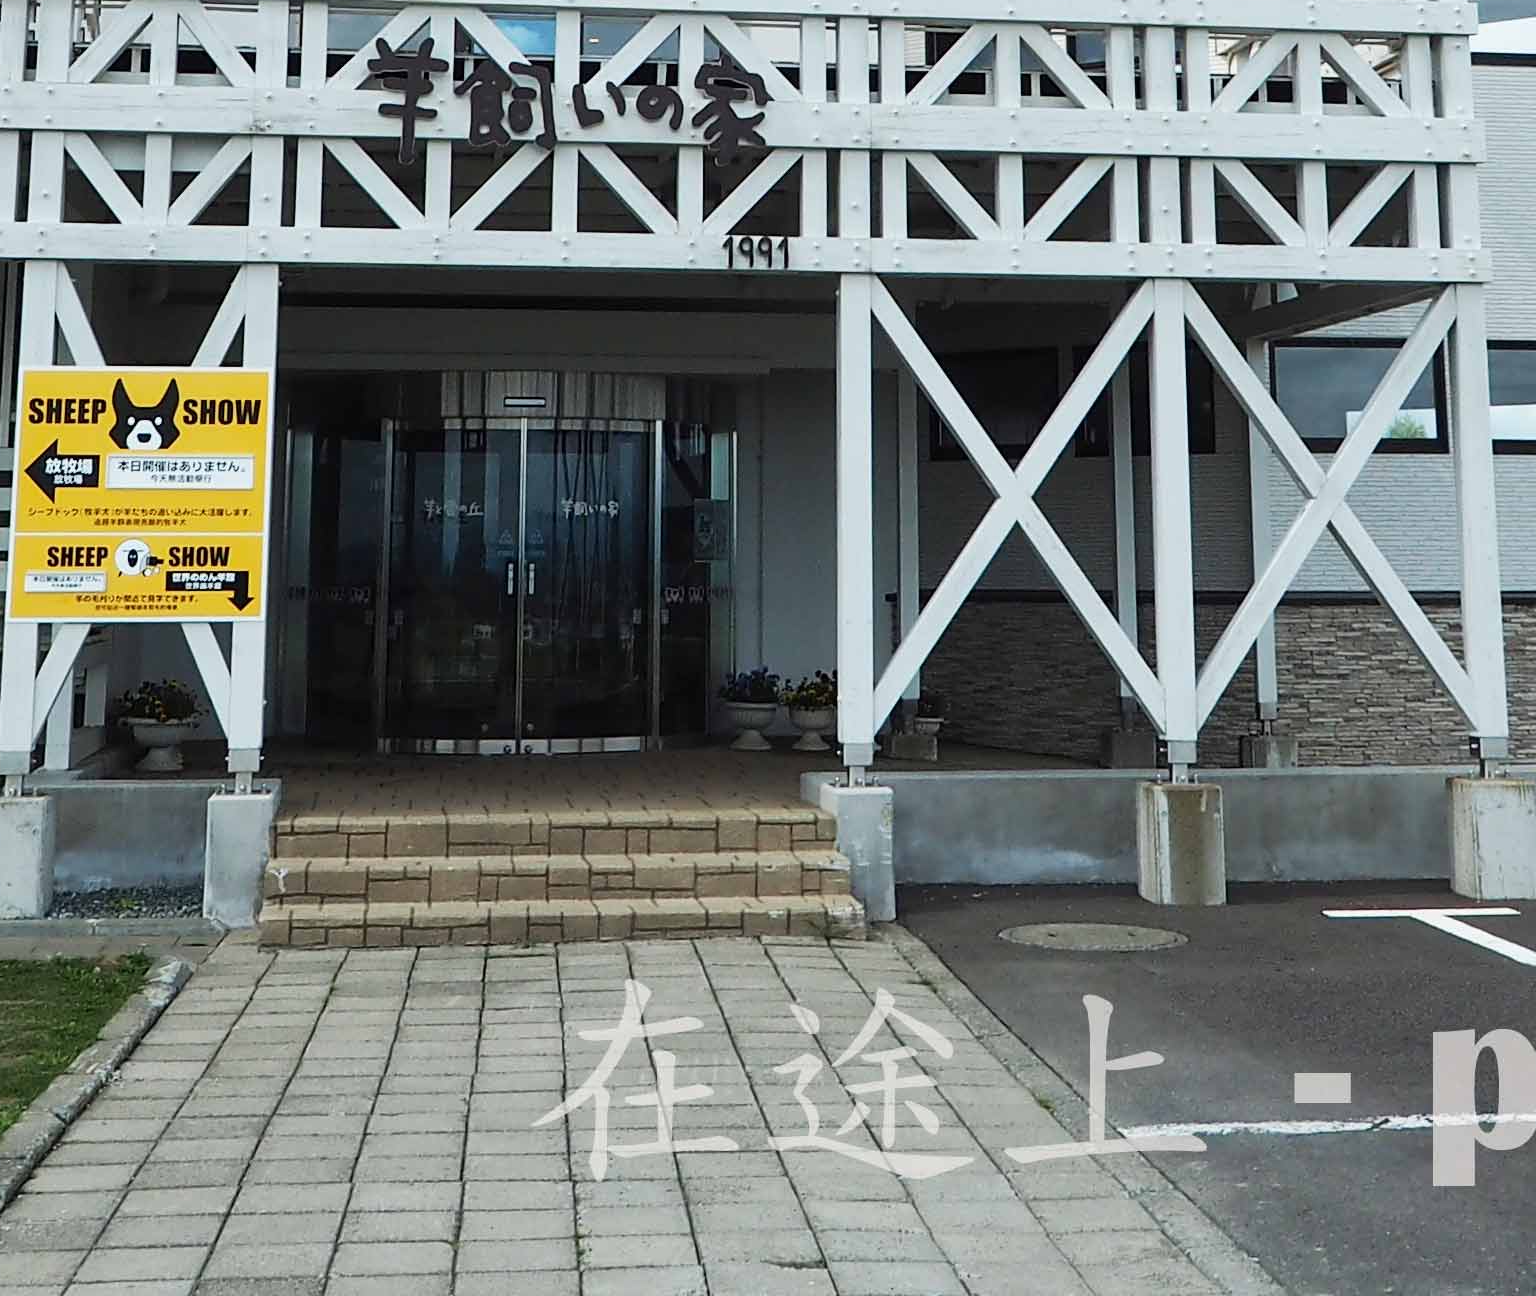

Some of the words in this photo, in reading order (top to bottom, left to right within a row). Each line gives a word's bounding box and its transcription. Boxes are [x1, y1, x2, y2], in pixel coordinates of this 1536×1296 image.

[367, 37, 774, 167] 羊飼いの家
[722, 235, 790, 269] 1991
[28, 398, 107, 425] SHEEP
[182, 399, 261, 425] SHOW
[117, 460, 247, 472] 本日開催はありません。
[47, 546, 109, 567] SHEEP
[168, 546, 230, 567] SHOW
